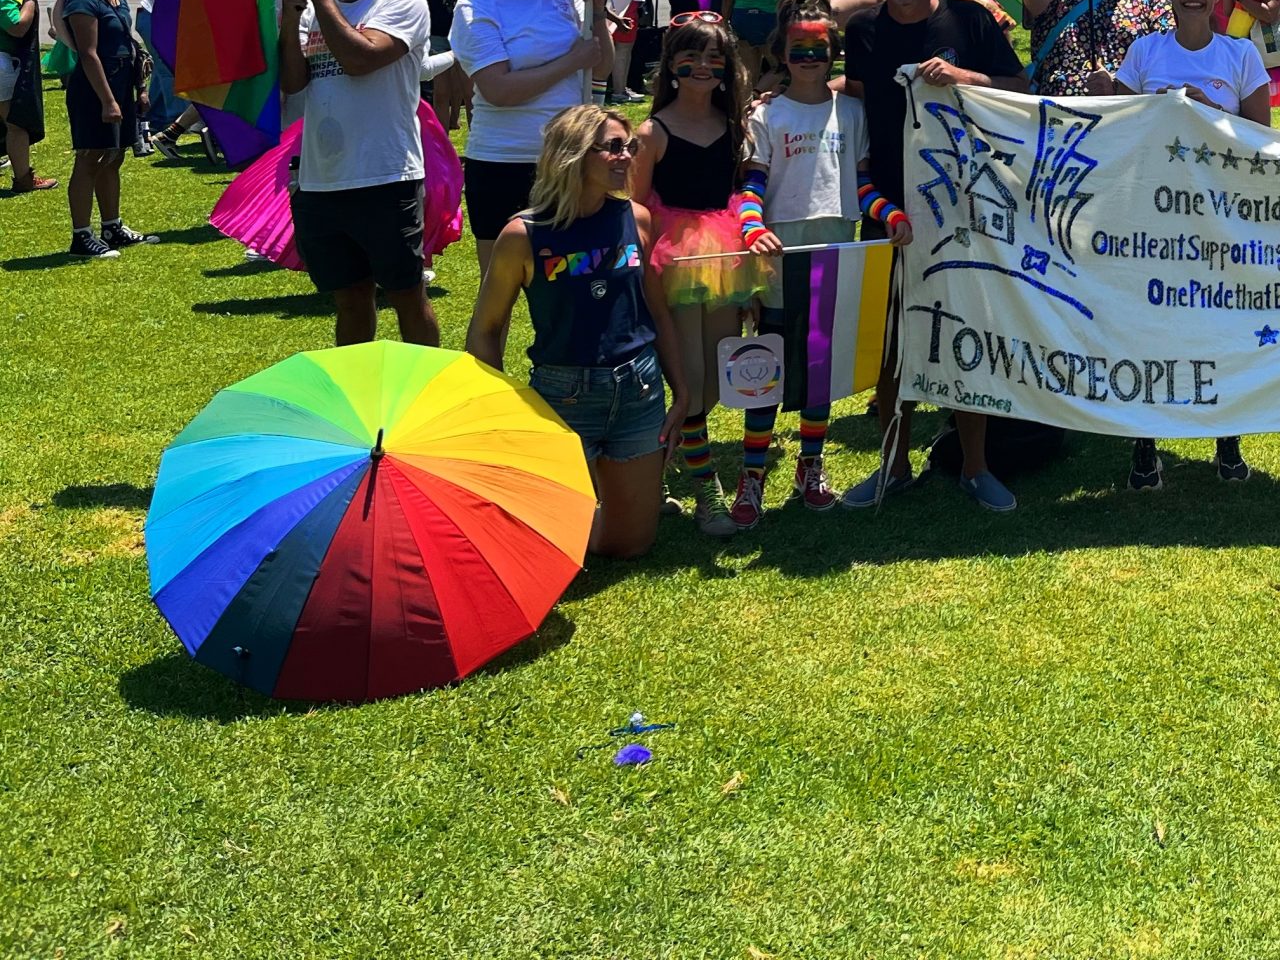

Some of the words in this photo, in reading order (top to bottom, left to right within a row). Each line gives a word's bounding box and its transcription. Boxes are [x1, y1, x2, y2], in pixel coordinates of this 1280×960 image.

[1154, 185, 1205, 216] One
[1091, 230, 1129, 258] One
[1132, 231, 1185, 261] Heart
[1147, 278, 1188, 308] One
[1189, 279, 1233, 309] Pride
[1234, 281, 1272, 311] that
